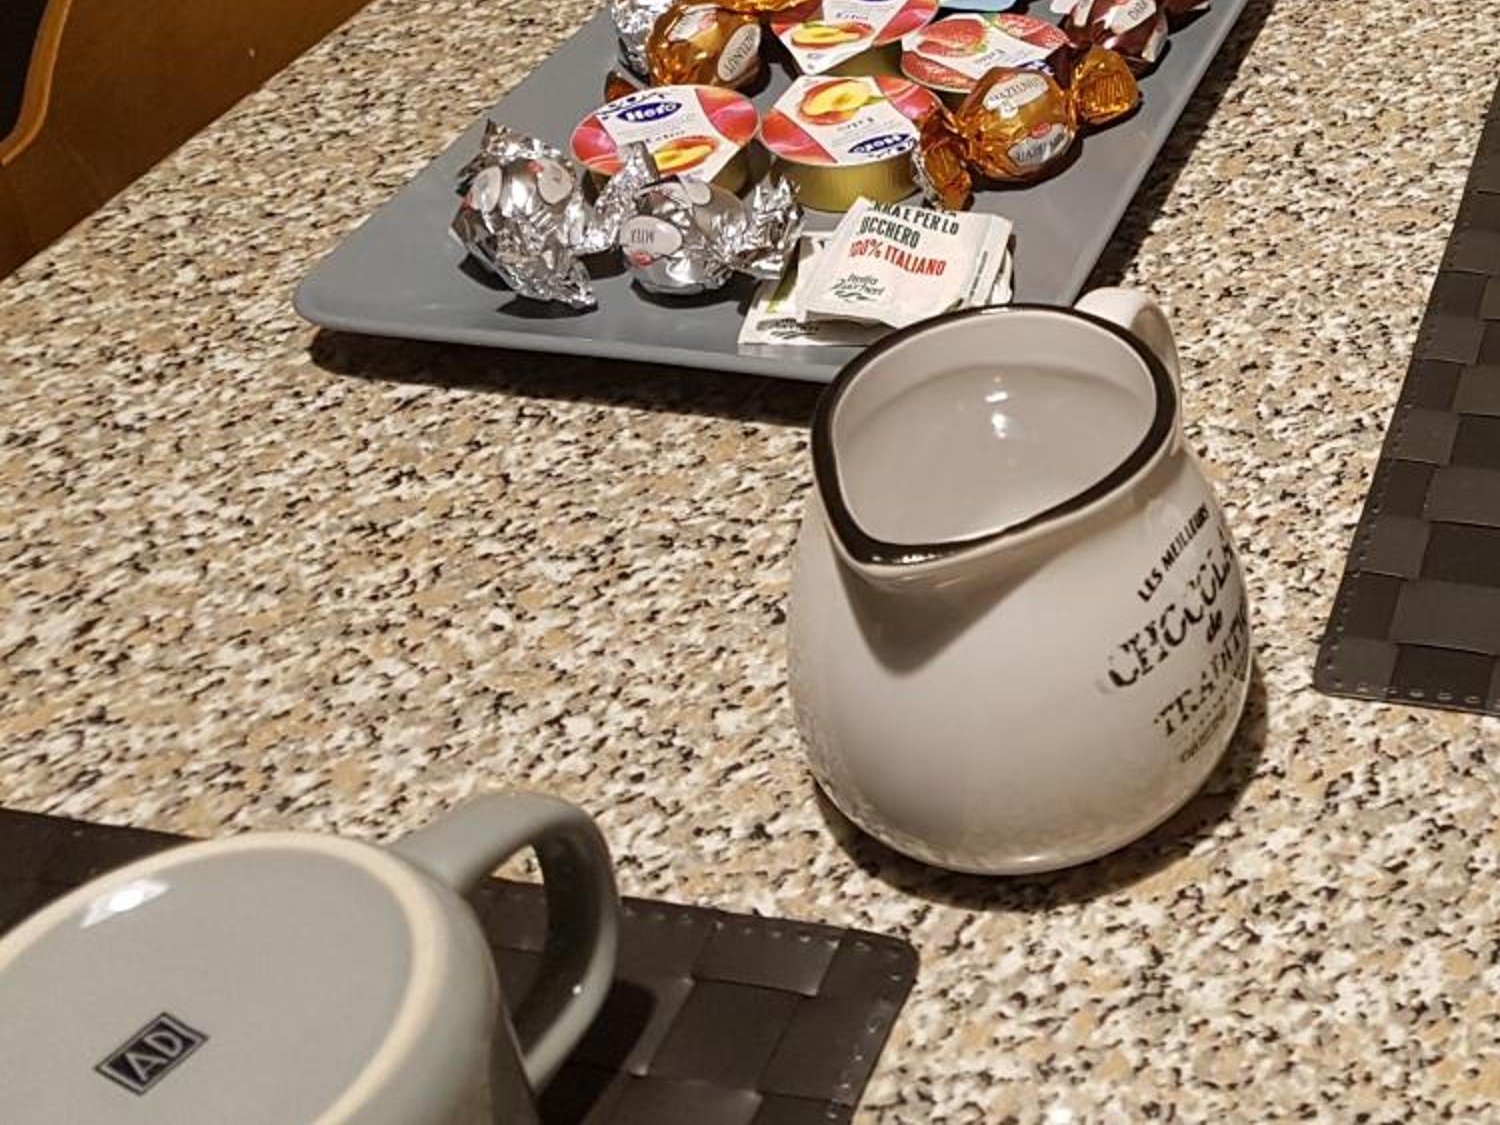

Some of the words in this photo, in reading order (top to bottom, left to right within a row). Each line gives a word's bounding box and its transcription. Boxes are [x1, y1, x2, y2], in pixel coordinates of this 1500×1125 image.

[625, 103, 677, 121] Hero
[857, 216, 921, 249] UCCHERO
[904, 207, 912, 221] E
[913, 209, 940, 230] PER
[942, 218, 960, 235] LO
[884, 245, 947, 276] ITALIANO
[1137, 568, 1163, 602] LES
